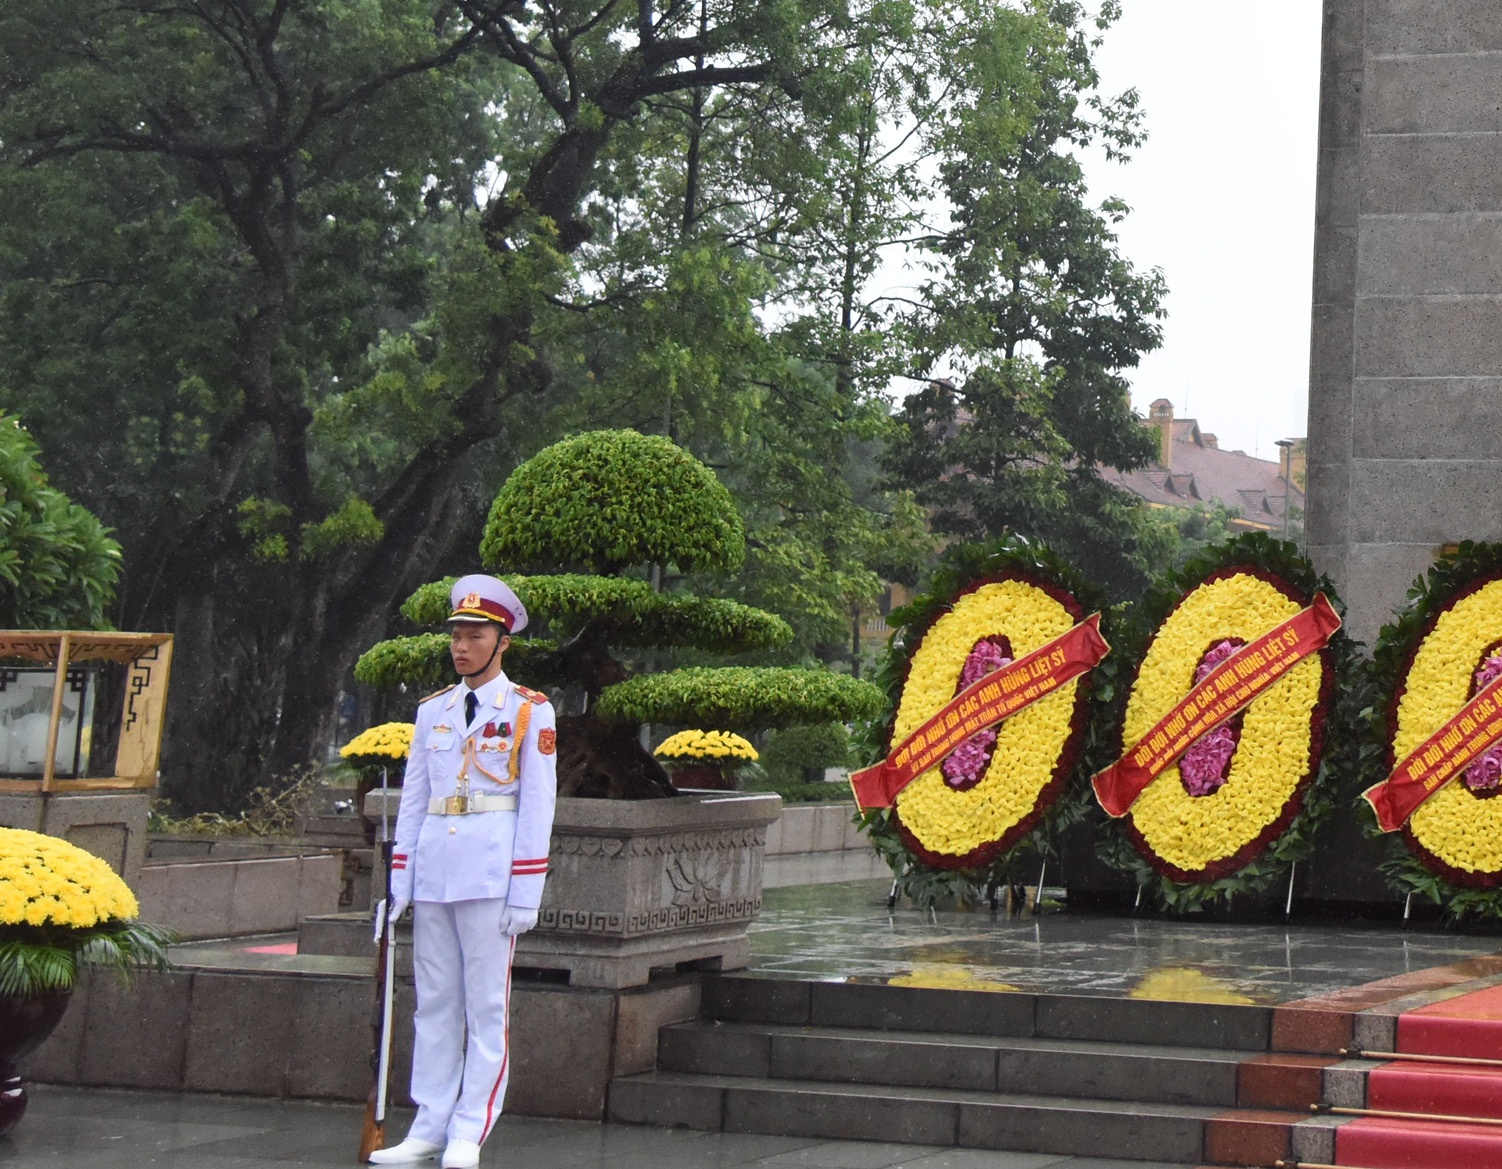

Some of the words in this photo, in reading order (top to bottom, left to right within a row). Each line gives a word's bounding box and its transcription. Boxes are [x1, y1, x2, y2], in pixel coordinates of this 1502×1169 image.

[895, 747, 910, 769] ĐỜI
[910, 733, 926, 755] ĐỜI
[926, 718, 946, 746] NHỚ
[946, 708, 959, 728] ƠN
[959, 696, 979, 718] CÁC
[979, 683, 1001, 705] ANH
[1000, 667, 1030, 690] HÙNG
[1029, 656, 1052, 678] LIỆT
[1051, 647, 1066, 667] SỸ
[1134, 746, 1153, 767] ĐỜI
[1149, 731, 1165, 753] ĐỜI
[1164, 712, 1186, 740] NHỚ
[1183, 703, 1200, 722] ƠN
[1196, 686, 1217, 709] CÁC
[1214, 669, 1238, 693] ANH
[1234, 651, 1266, 679] HÙNG
[1261, 638, 1286, 660] LIỆT
[1283, 626, 1299, 646] SỸ
[1407, 758, 1427, 780] ĐỜI
[1423, 741, 1443, 767] ĐỜI
[1439, 724, 1463, 753] NHỚ
[1459, 714, 1477, 735] ƠN
[1473, 698, 1496, 723] CÁC
